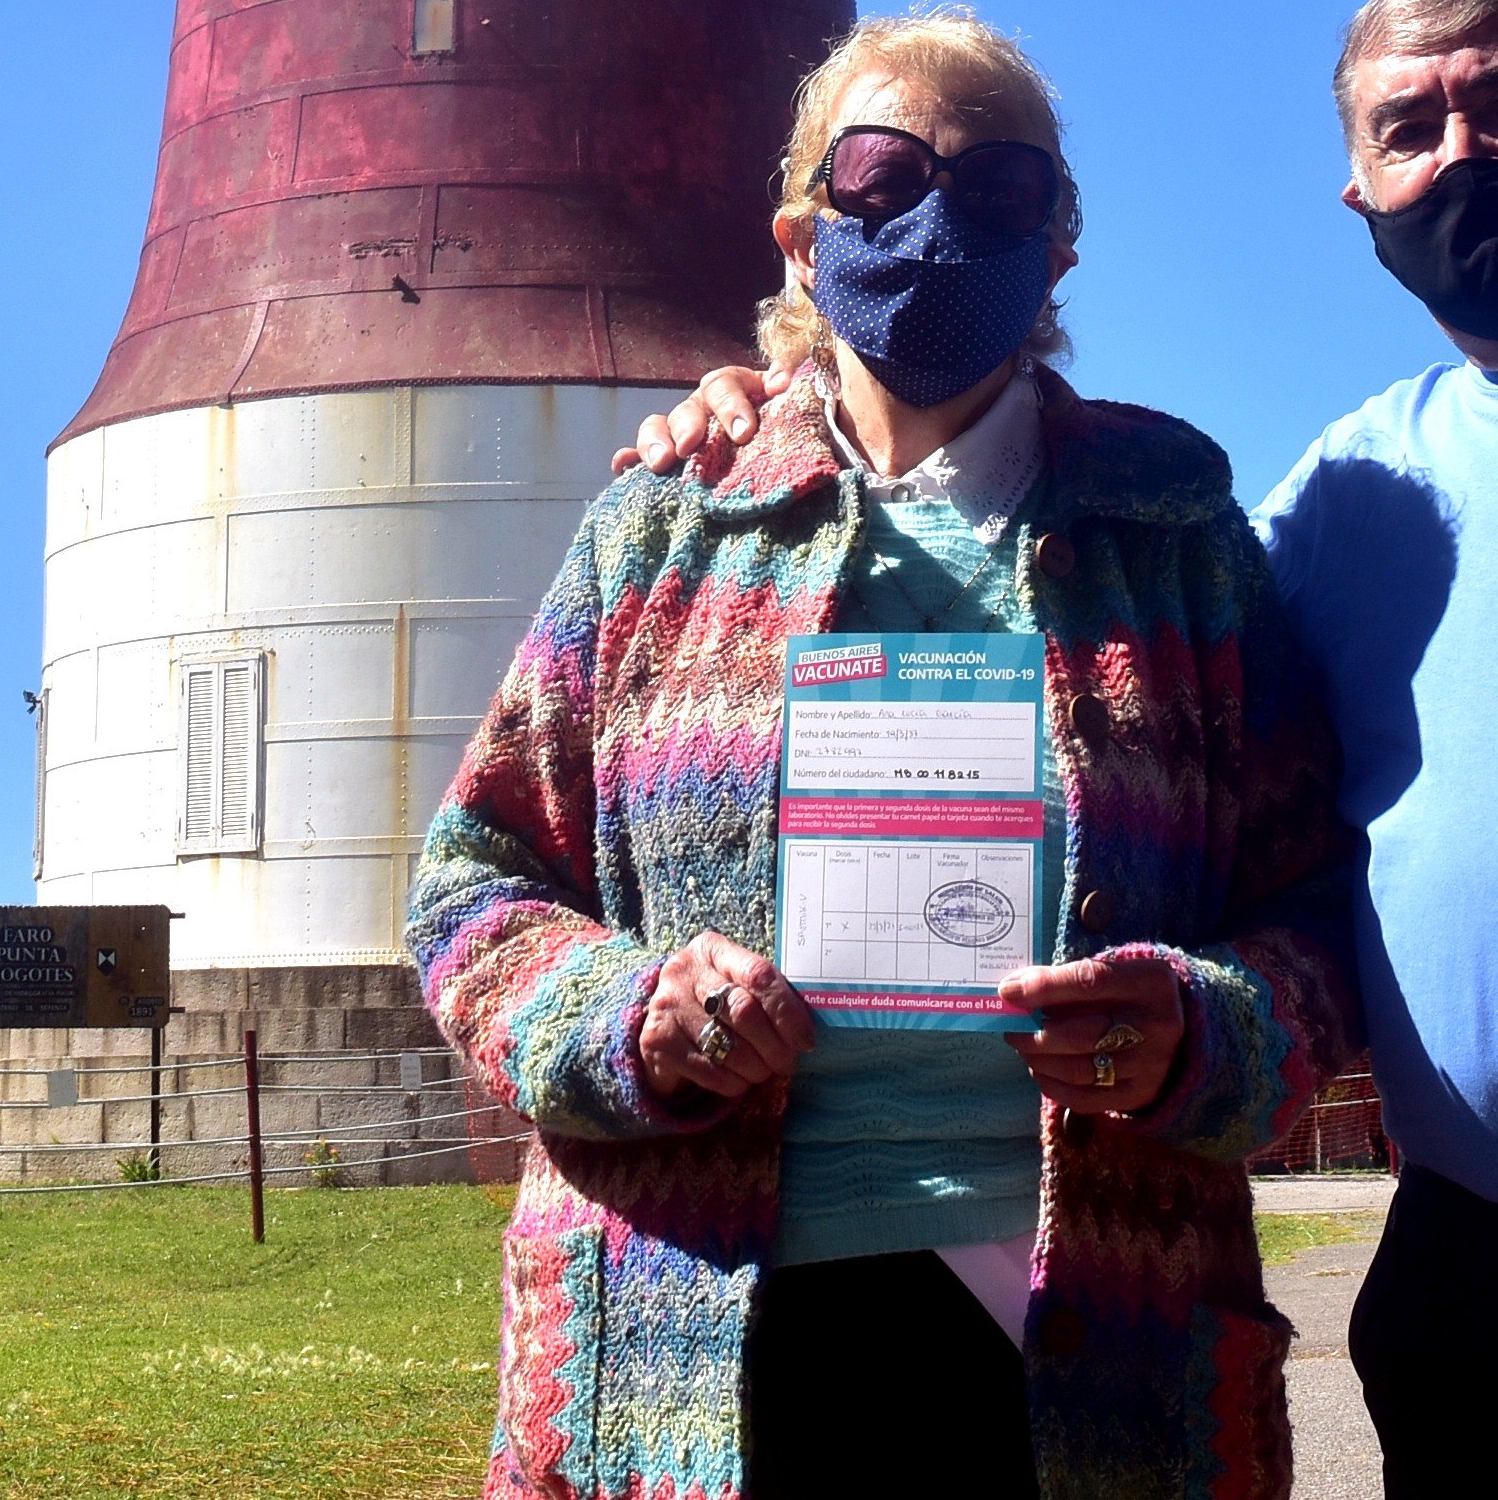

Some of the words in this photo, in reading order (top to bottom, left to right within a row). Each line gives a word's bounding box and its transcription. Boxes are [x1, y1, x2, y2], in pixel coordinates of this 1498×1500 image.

[801, 650, 845, 663] BUENOS
[849, 645, 880, 660] AIRES
[899, 650, 986, 664] VACUNACIÓN
[793, 657, 883, 683] VACUNATE
[898, 668, 953, 680] CONTRA
[956, 668, 971, 680] EL
[974, 668, 1035, 680] COVID-19
[796, 711, 828, 719] Nombre
[831, 712, 836, 720] y
[837, 711, 872, 720] Apellido:
[795, 730, 819, 738] Fecha
[821, 730, 831, 738] de
[833, 730, 879, 738] Nacimiento:
[794, 768, 826, 778] Número
[829, 769, 841, 778] del
[843, 769, 885, 778] ciudadano:
[4, 928, 52, 943] FARO
[804, 994, 825, 1004] Ante
[828, 996, 869, 1007] cualquier
[871, 997, 894, 1006] duda
[896, 998, 954, 1008] comunicarse
[975, 1000, 983, 1008] el
[986, 1000, 1002, 1009] 148
[131, 1007, 153, 1016] 1891
